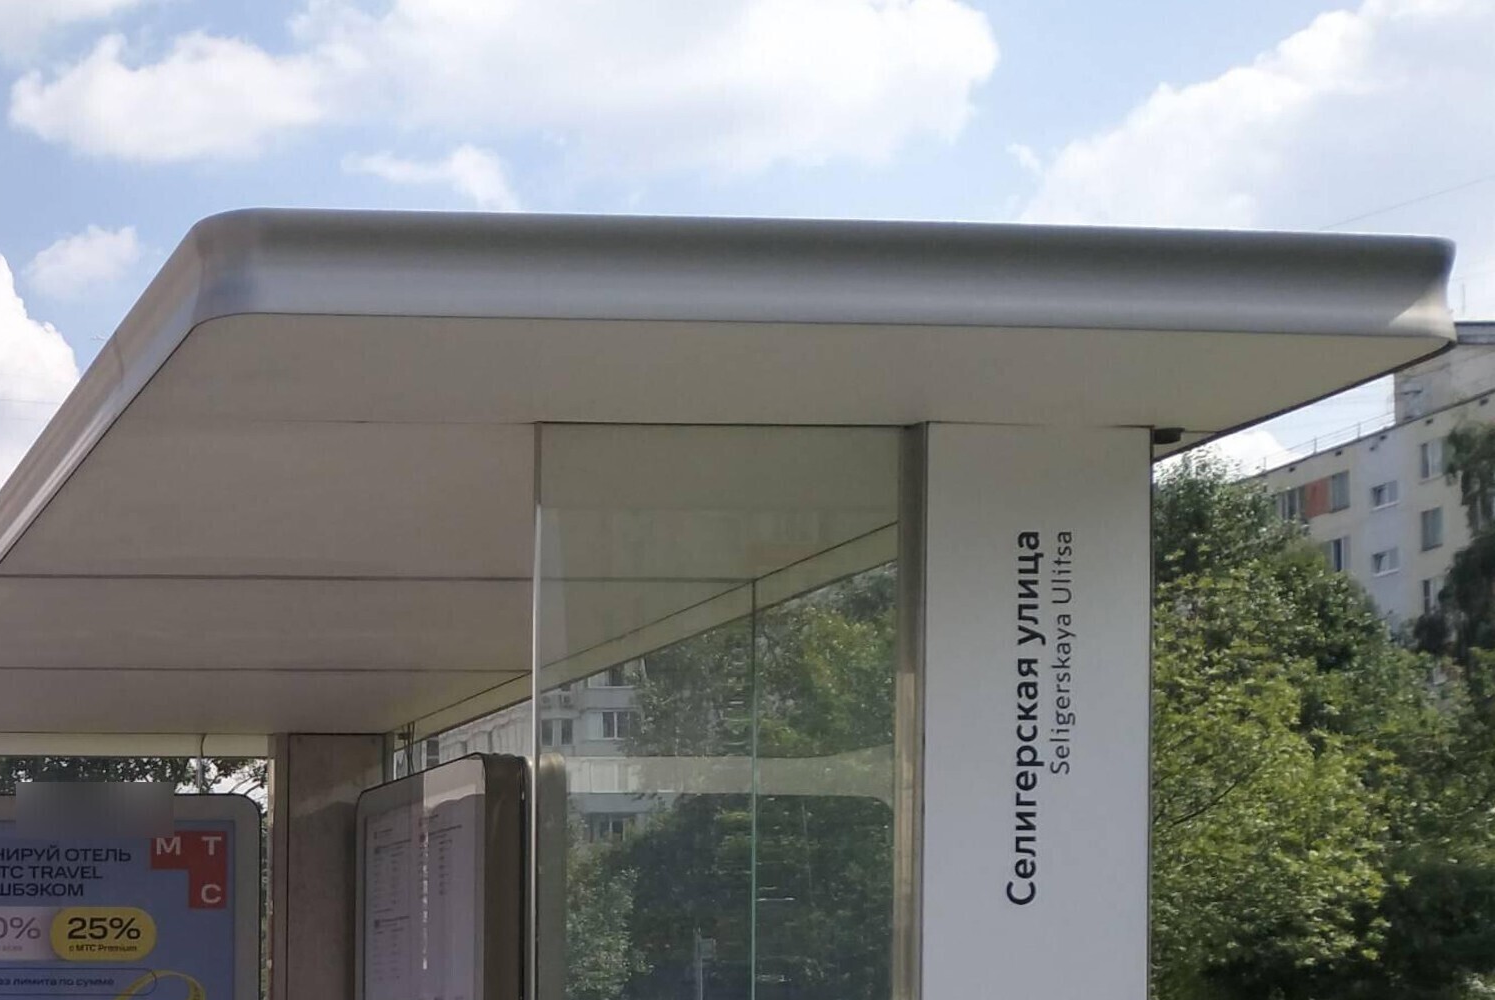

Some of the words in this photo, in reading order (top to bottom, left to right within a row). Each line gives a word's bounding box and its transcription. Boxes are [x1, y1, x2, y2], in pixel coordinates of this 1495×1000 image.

[1016, 530, 1046, 646] улица
[1051, 530, 1073, 604] Ulitsa
[1050, 612, 1077, 775] Seligerskaya
[1006, 657, 1045, 906] Селигерская
[32, 866, 103, 880] TRAVEL
[65, 848, 132, 863] ОТЕЛЬ
[67, 917, 142, 941] 25%
[76, 979, 115, 989] сумме
